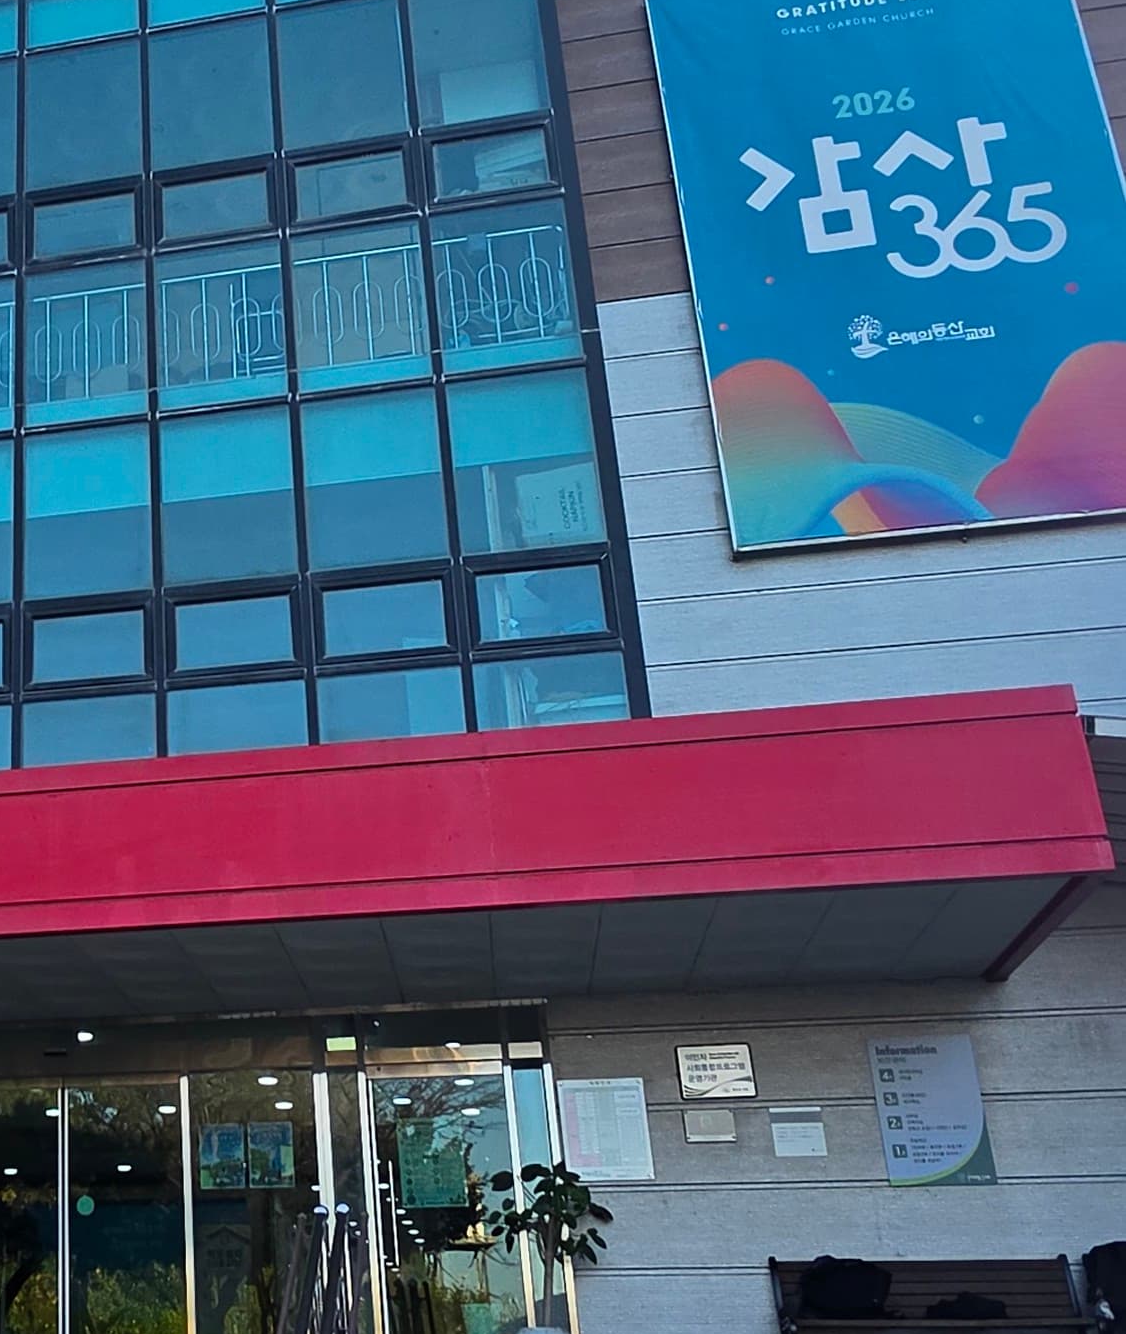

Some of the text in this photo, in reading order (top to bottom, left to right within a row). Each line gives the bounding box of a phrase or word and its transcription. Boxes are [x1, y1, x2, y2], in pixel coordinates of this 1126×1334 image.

[781, 7, 934, 36] GRACE GARDEN CHURCH
[832, 87, 916, 119] 2026
[739, 116, 1008, 254] 감사
[886, 181, 1068, 279] 365
[886, 320, 996, 346] 은혜의동산교회
[875, 1045, 937, 1056] Information
